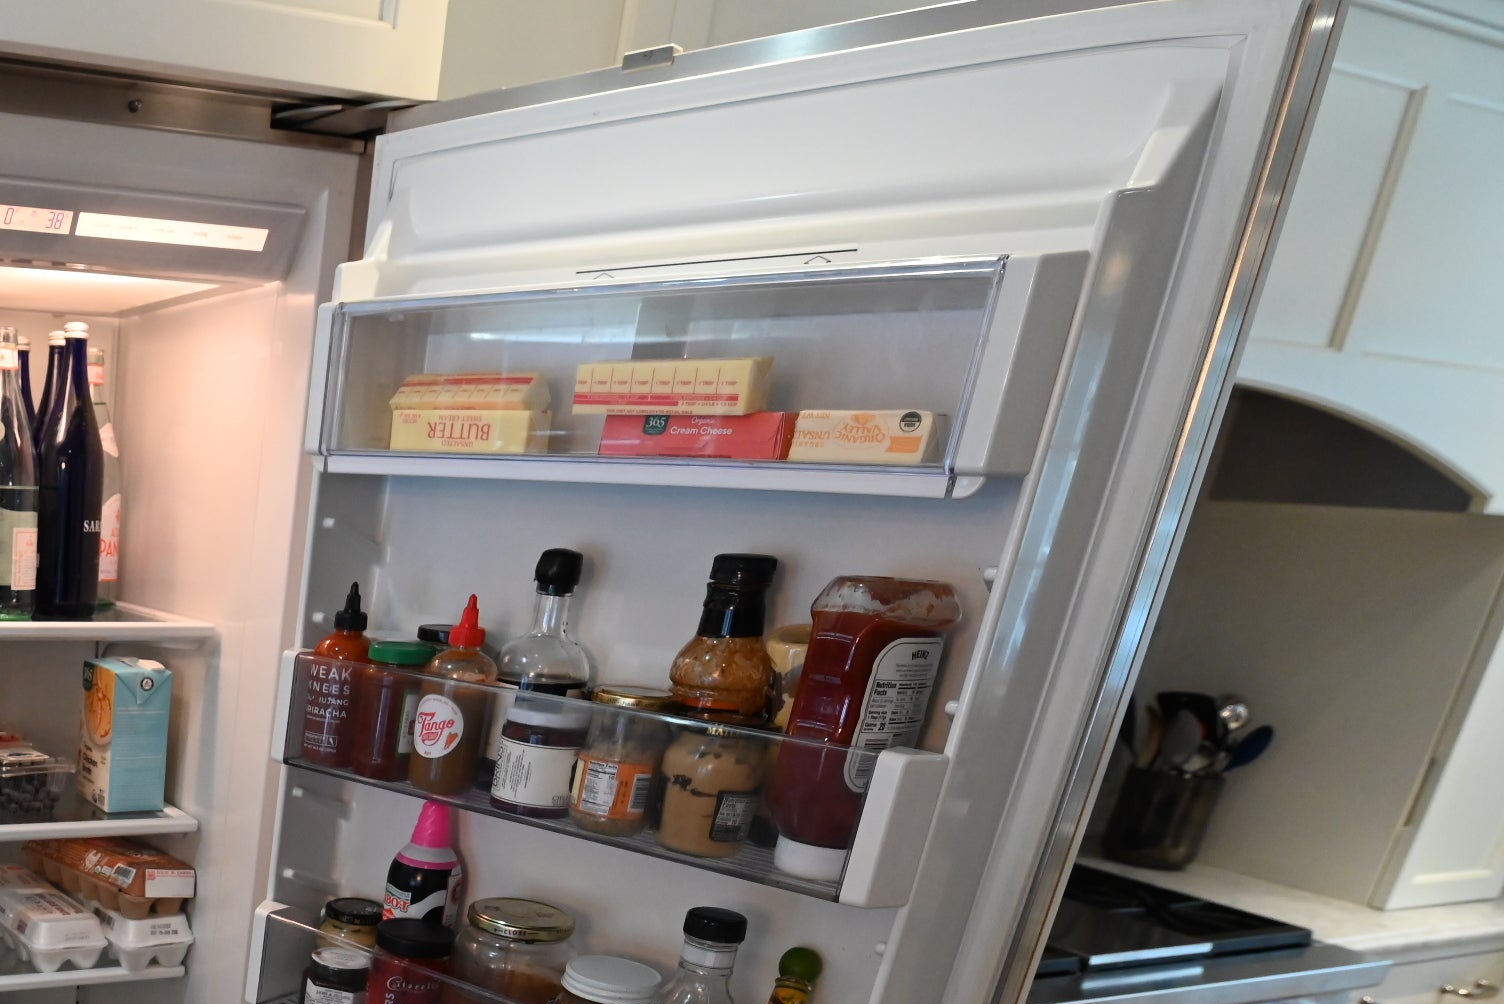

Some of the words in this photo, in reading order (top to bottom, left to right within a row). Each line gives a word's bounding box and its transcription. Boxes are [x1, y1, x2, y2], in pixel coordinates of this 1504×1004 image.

[45, 211, 65, 230] 38
[645, 416, 667, 429] 365
[426, 422, 492, 440] BUTTER
[670, 426, 698, 435] Cream
[700, 426, 733, 435] Cheese
[841, 423, 883, 435] VALLEY
[834, 431, 886, 444] ORGANIC
[440, 440, 474, 448] UNSALTED
[911, 649, 930, 661] HEINZ
[875, 681, 897, 689] Nutrition
[873, 688, 887, 696] Facts
[417, 711, 456, 746] Tango
[503, 929, 528, 937] CLOSE
